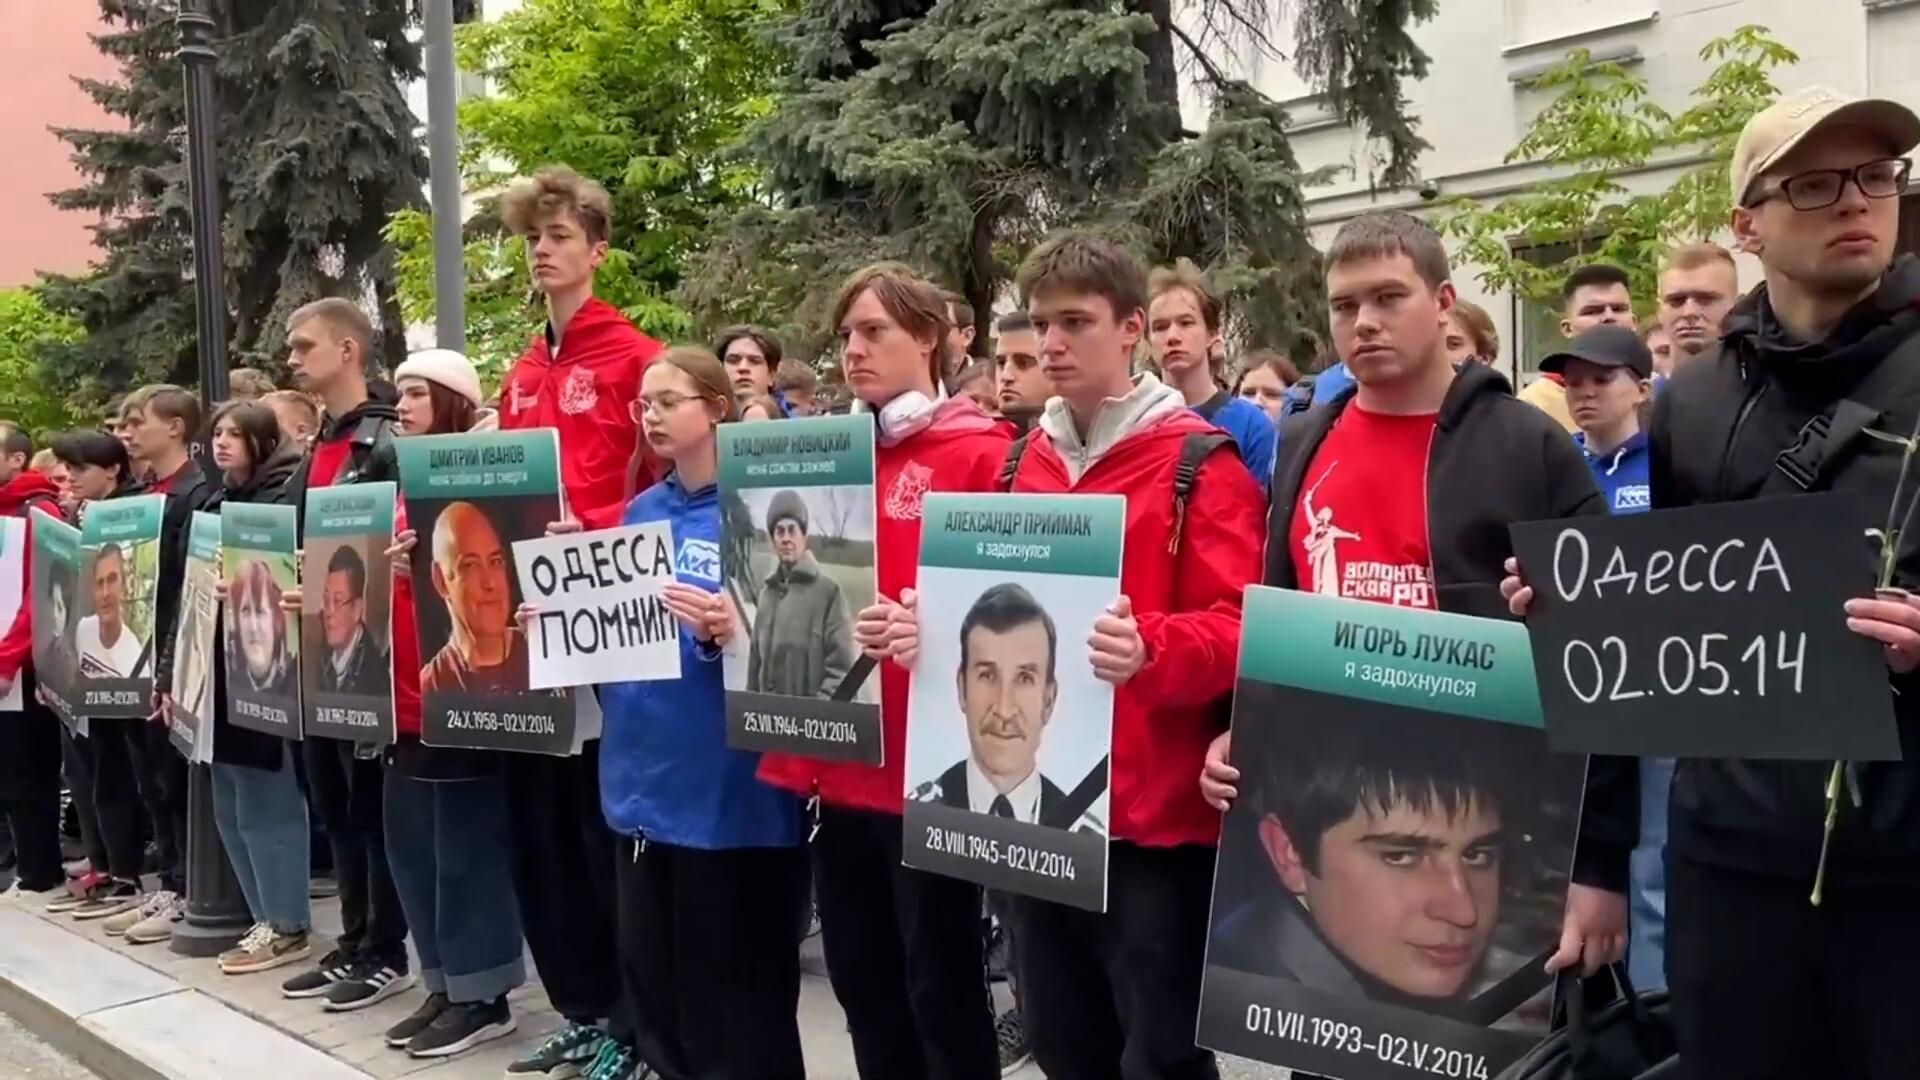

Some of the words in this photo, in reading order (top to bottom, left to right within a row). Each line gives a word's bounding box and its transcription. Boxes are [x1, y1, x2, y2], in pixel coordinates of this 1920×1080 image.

[430, 445, 480, 469] ДМИТРИЙ
[482, 445, 524, 467] ИВАНОВ
[733, 434, 788, 457] ВЛАДИМИР
[791, 431, 850, 454] НОВИЦКИЙ
[944, 511, 1021, 536] АЛЕКСАНДР
[1023, 509, 1092, 536] ПРИЙМАК
[531, 534, 671, 596] ОДЕССА
[976, 542, 984, 555] я
[985, 542, 1051, 562] задохнулся
[1393, 582, 1432, 606] РО
[1334, 620, 1407, 658] ИГОРЬ
[1412, 633, 1496, 670] ЛУКАС
[1344, 662, 1355, 678] я
[1361, 664, 1477, 698] задохнулся
[1563, 630, 1806, 703] 02.05.14
[1245, 1003, 1488, 1080] 01.VII.1993-02.V.2014
